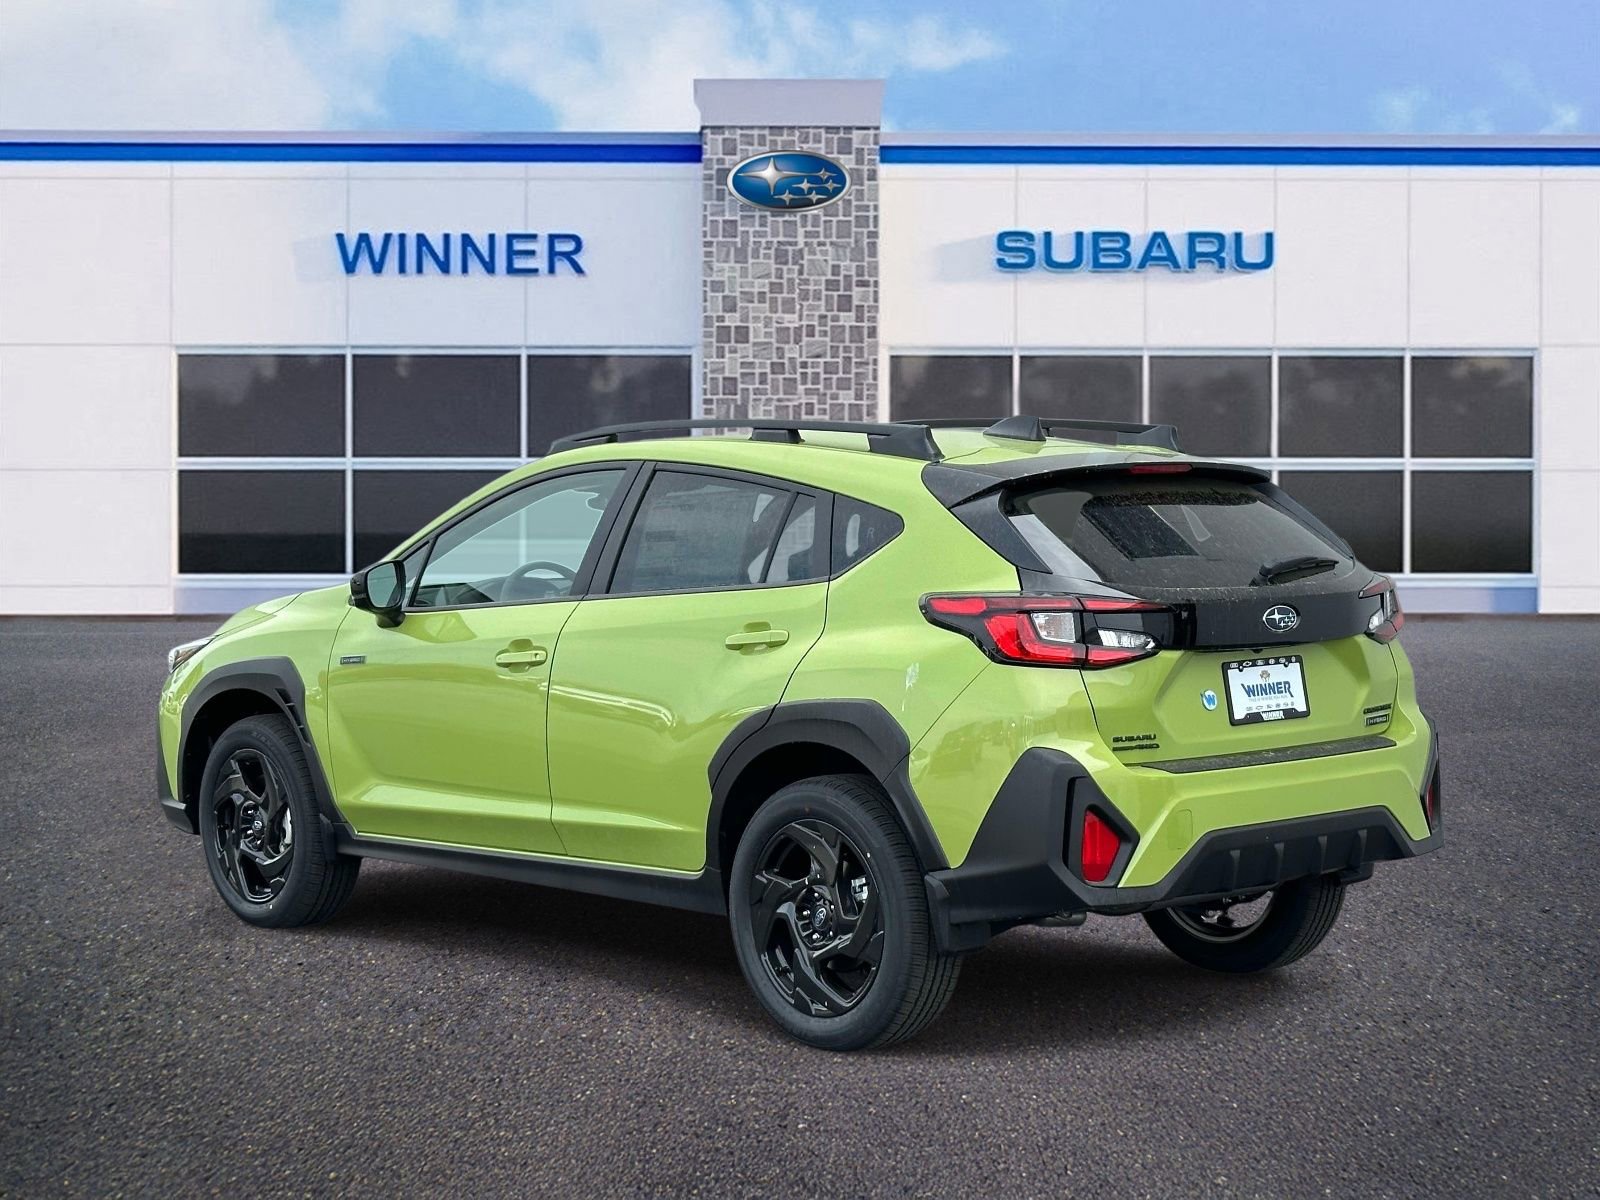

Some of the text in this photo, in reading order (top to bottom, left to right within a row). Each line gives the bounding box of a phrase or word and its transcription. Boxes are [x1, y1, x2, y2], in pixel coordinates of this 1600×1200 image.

[335, 232, 586, 276] WINNER
[996, 230, 1275, 271] SUBARU
[1241, 681, 1294, 698] WINNER
[1260, 710, 1285, 721] WINNER
[1112, 733, 1157, 743] SUBARU
